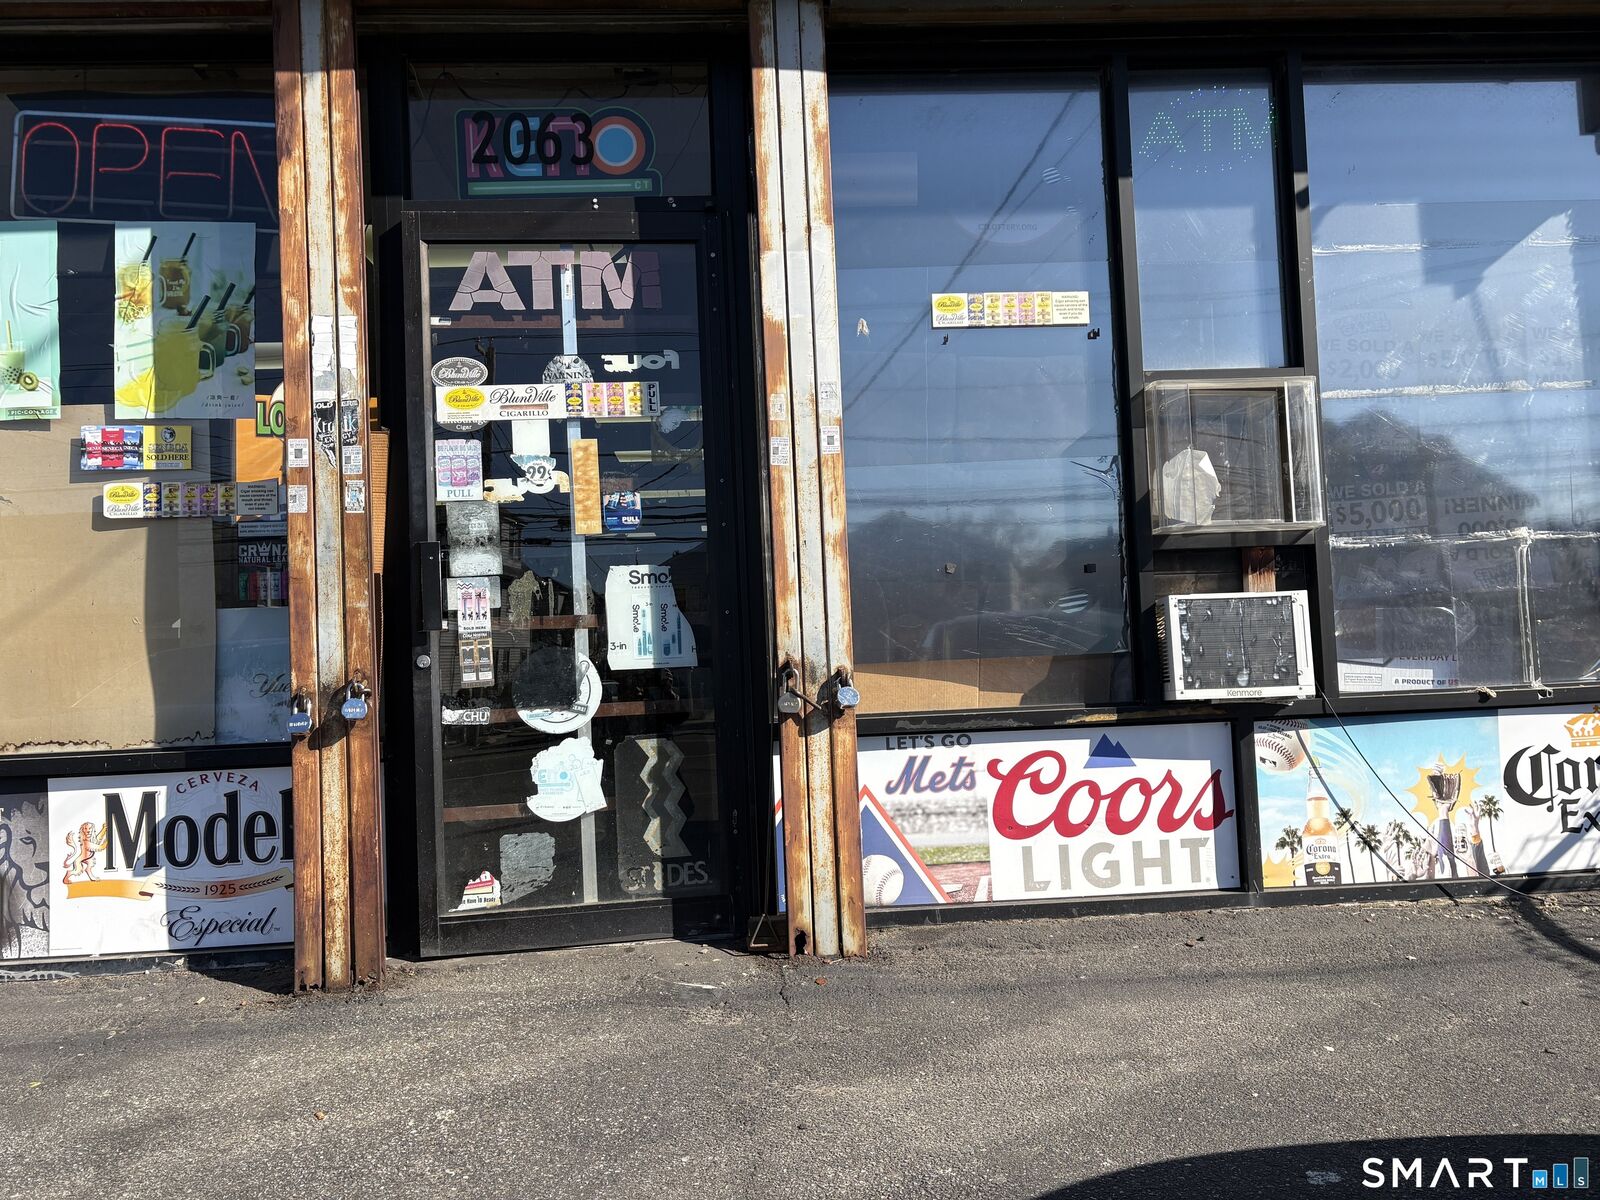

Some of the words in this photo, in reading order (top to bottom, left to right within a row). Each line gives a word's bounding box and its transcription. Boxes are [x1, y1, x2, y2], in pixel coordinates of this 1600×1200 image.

[471, 111, 594, 166] 2063
[1138, 107, 1274, 153] ATM
[20, 121, 277, 222] OPEN
[634, 180, 651, 190] CT
[448, 250, 662, 311] ATM
[490, 385, 557, 405] BluntVille
[648, 384, 657, 412] PULL
[447, 489, 473, 498] PULL
[1361, 481, 1408, 497] SOLD
[1336, 498, 1421, 529] $5,000
[610, 642, 627, 650] 3-in
[1402, 678, 1435, 686] PRODUCT
[1226, 689, 1263, 697] Kenmore
[885, 735, 935, 750] LET'S
[941, 733, 972, 748] GO
[176, 772, 260, 793] CERVEZA
[885, 755, 977, 795] Mets
[986, 750, 1235, 840] Coors
[1306, 844, 1337, 855] Corona
[1021, 837, 1210, 892] LIGHT
[204, 883, 237, 895] 1925
[160, 905, 277, 946] Especial
